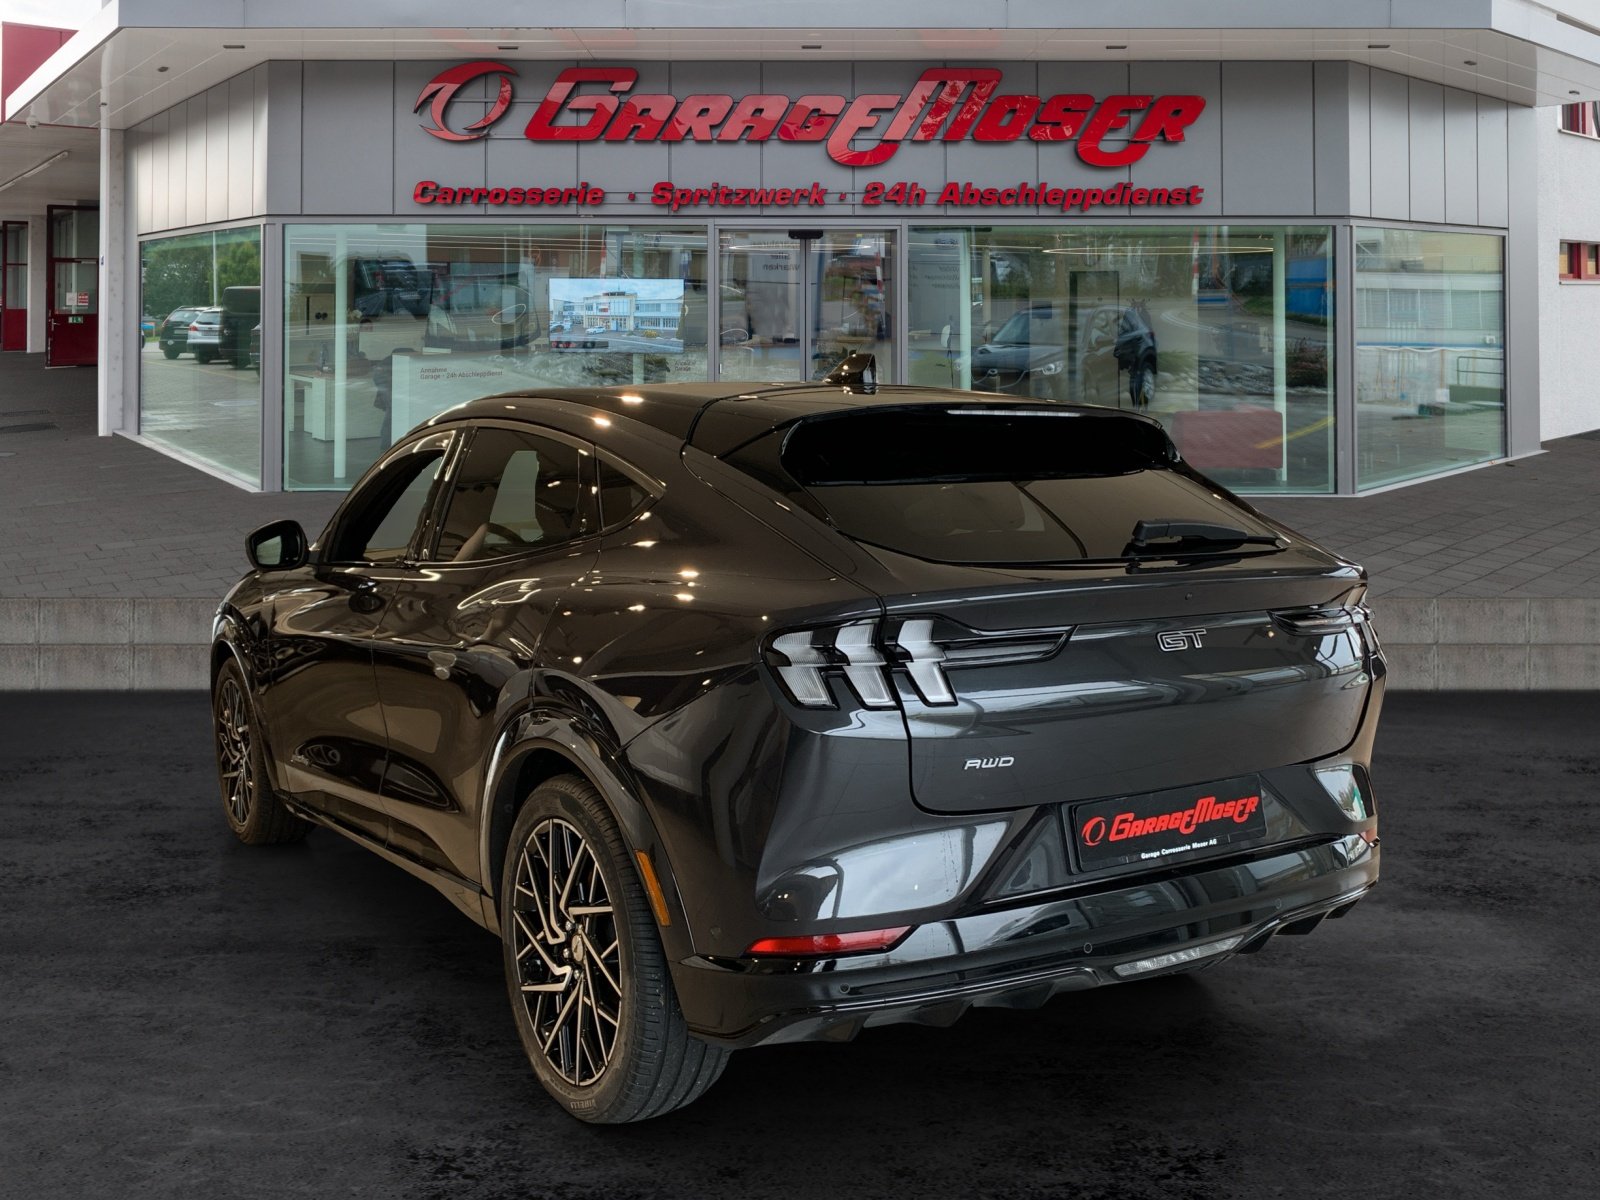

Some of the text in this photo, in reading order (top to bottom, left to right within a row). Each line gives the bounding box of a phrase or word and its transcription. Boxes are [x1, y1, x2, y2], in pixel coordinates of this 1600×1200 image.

[413, 180, 1204, 211] Carrosserie Spritzwerk 24h Abschleppdienst
[420, 373, 441, 381] Garage
[458, 370, 503, 378] Abschleppdienst
[1157, 628, 1207, 652] GT
[964, 756, 1015, 770] AWD
[1140, 838, 1218, 860] Garage Carrosserie Moser AG
